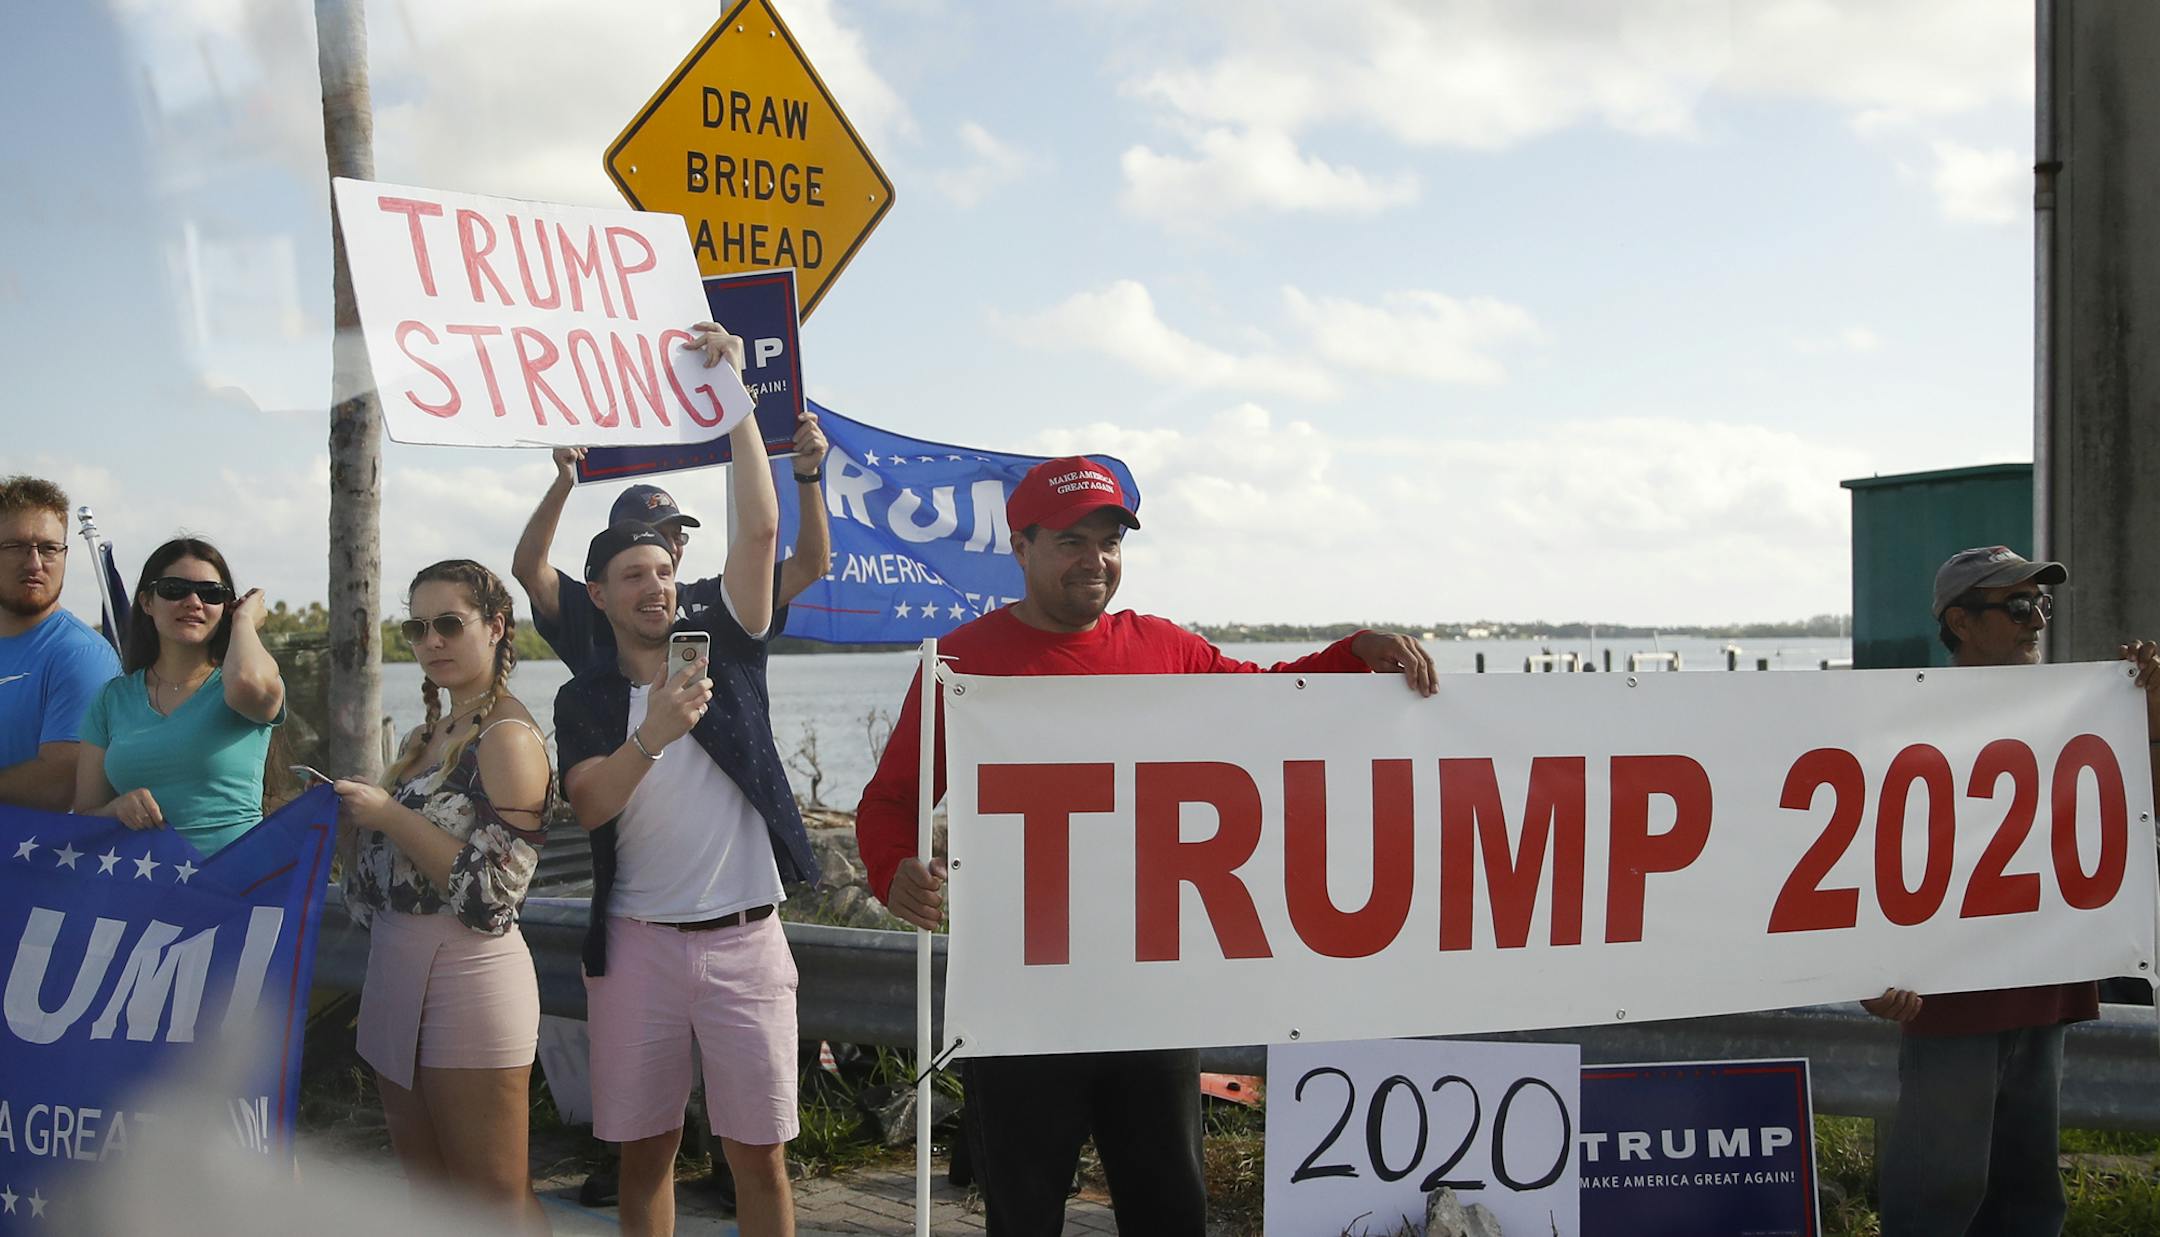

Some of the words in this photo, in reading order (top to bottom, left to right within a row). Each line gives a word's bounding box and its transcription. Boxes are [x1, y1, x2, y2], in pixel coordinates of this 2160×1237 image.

[702, 86, 808, 140] DRAW
[687, 151, 824, 207] BRIDGE
[377, 195, 657, 320] TRUMP
[695, 219, 823, 269] AHEAD
[395, 320, 725, 429] STRONG
[751, 380, 787, 394] GAIN!
[1048, 471, 1078, 486] MAKE
[1080, 470, 1114, 486] AMERICA
[1057, 481, 1090, 495] GREAT
[1091, 481, 1115, 494] AGAIN
[841, 553, 943, 585] AMERIC
[977, 755, 1713, 966] TRUMP
[1766, 733, 2127, 934] 2020
[1290, 1067, 1571, 1192] 2020
[1580, 1127, 1793, 1162] TRUMP
[1580, 1175, 1619, 1189] MAKE
[1624, 1173, 1689, 1188] AMERICA
[1694, 1172, 1740, 1186] GREAT
[1744, 1171, 1795, 1185] AGAIN!
